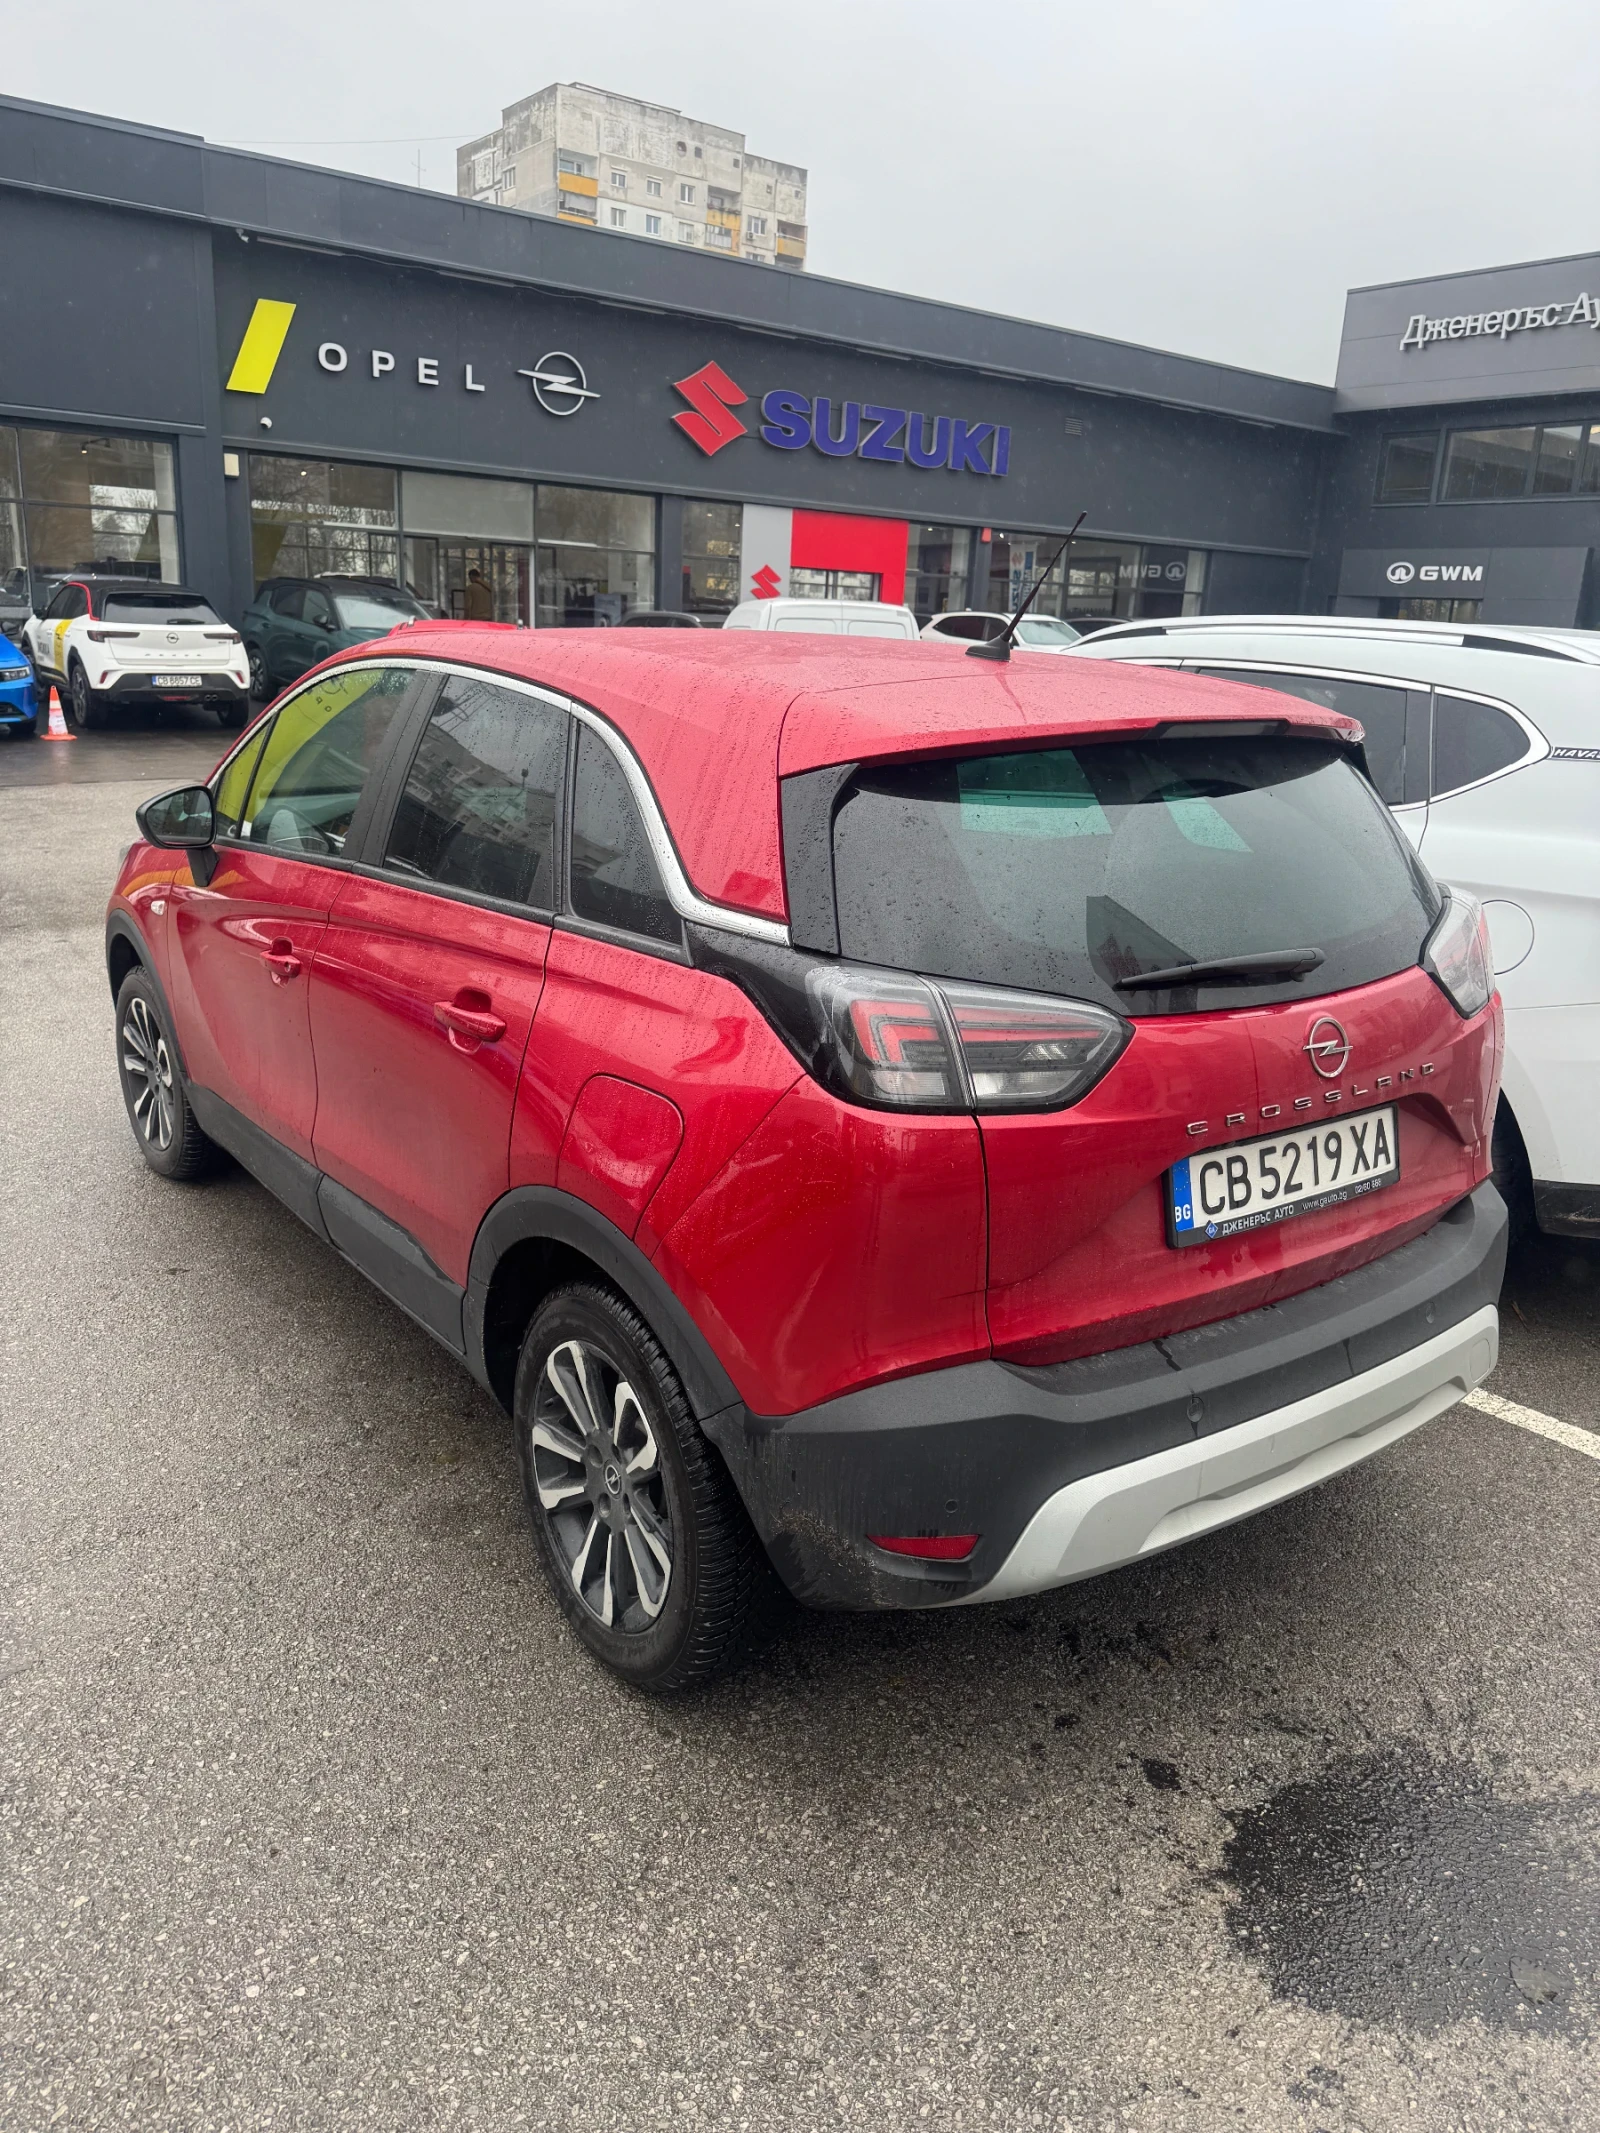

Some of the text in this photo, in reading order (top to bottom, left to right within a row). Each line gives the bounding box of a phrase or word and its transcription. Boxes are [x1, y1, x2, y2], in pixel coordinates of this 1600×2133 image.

[1399, 303, 1562, 351] Дженеръс
[318, 342, 485, 392] OPEL
[759, 389, 1012, 477] SUZUKI
[1419, 565, 1483, 581] GWM
[1554, 748, 1600, 758] HAVA
[1187, 1062, 1435, 1135] CROSSLAND
[1174, 1203, 1191, 1223] BG
[1301, 1191, 1348, 1210] www.gauto.bg
[1222, 1204, 1295, 1236] ДЖЕНЕРЪС АУТО
